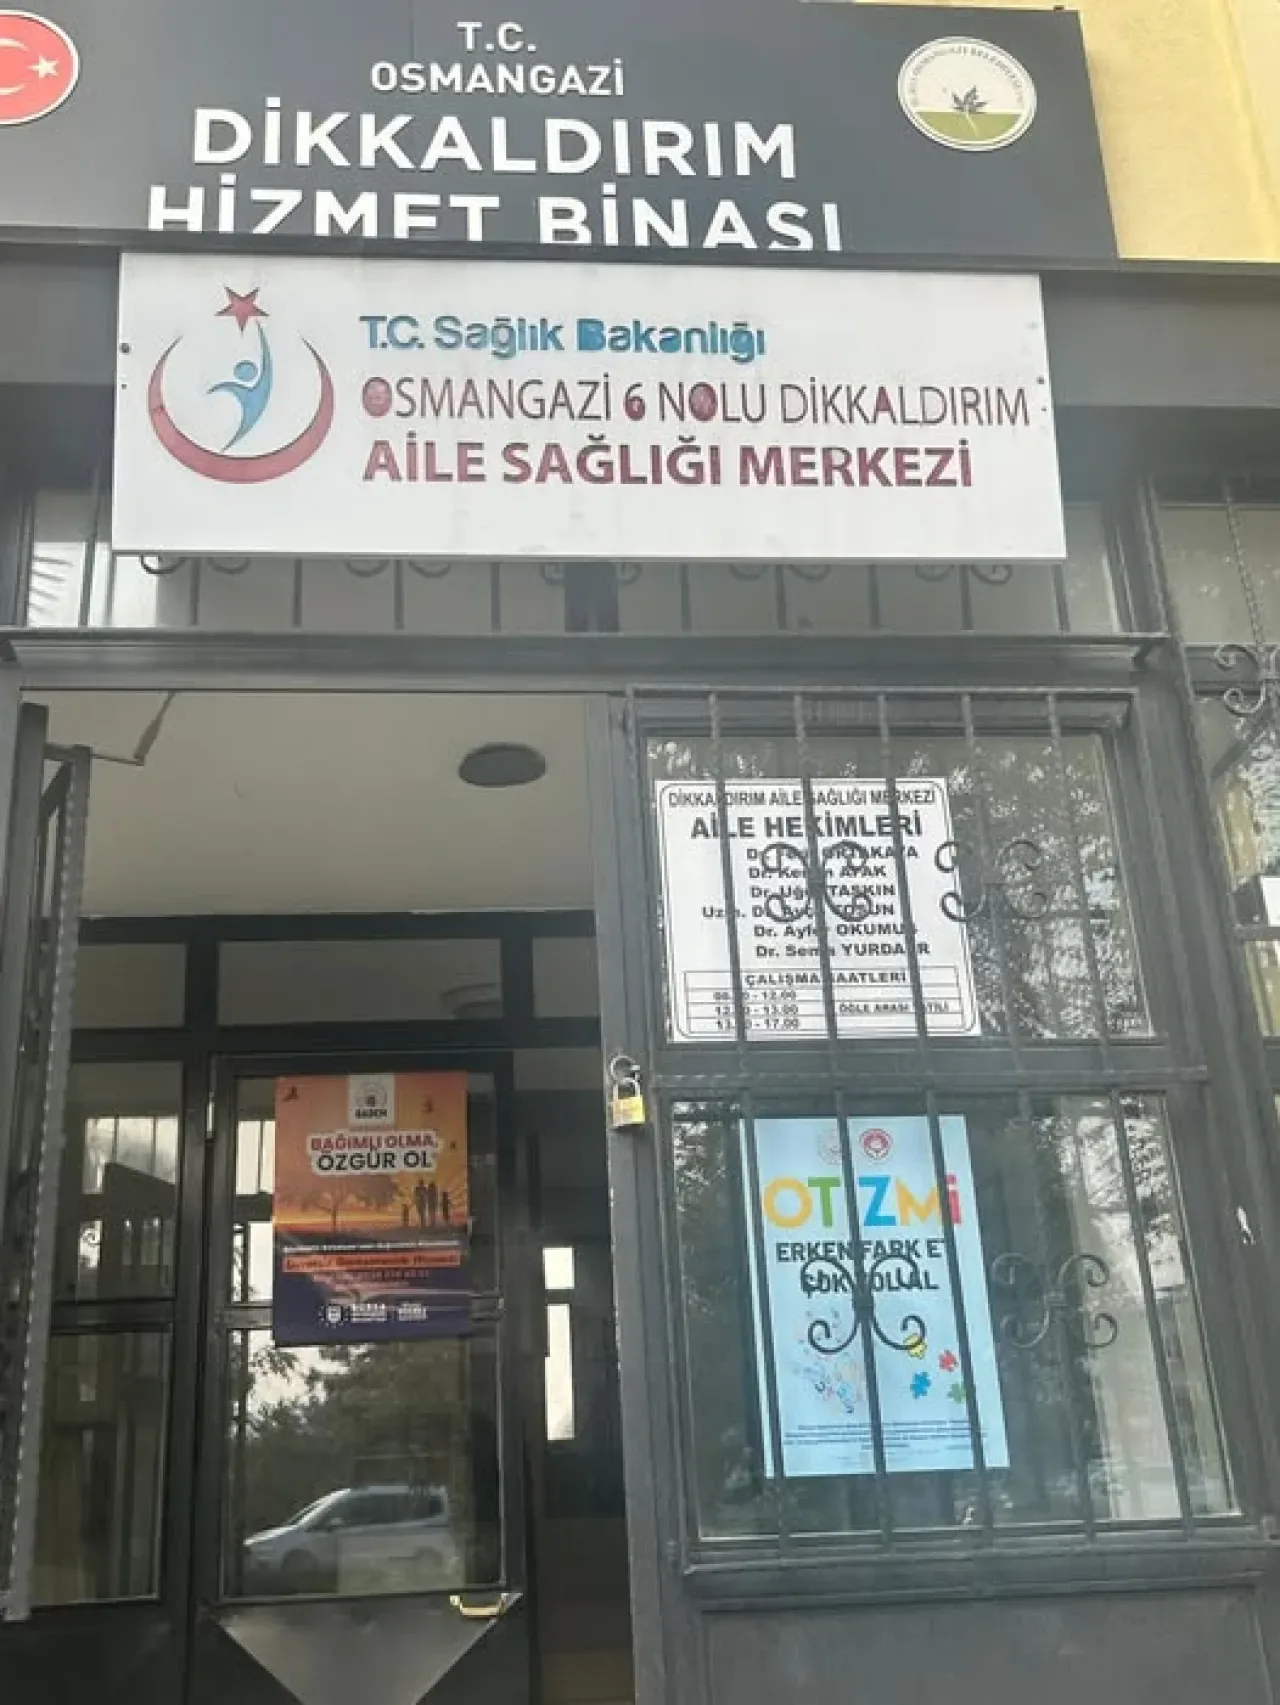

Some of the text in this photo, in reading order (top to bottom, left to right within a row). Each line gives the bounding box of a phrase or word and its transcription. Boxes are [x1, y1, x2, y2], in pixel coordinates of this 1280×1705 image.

[457, 21, 537, 53] T.C.
[370, 58, 625, 97] OSMANGAZİ
[193, 96, 798, 179] DİKKALDIRIM
[147, 173, 843, 252] HİZMET BİNASI
[359, 314, 767, 364] T.C. Sağlık Bakanlığı
[361, 372, 1031, 427] OSMANGAZİ 6 NOLU DİKKALDIRIM
[362, 430, 975, 488] AİLE SAĞLIĞI MERKEZİ
[668, 787, 765, 807] DİKKADIRIM
[807, 787, 867, 806] AĞLIĞI
[837, 923, 918, 937] OKUMU
[828, 969, 906, 983] AATLERİ
